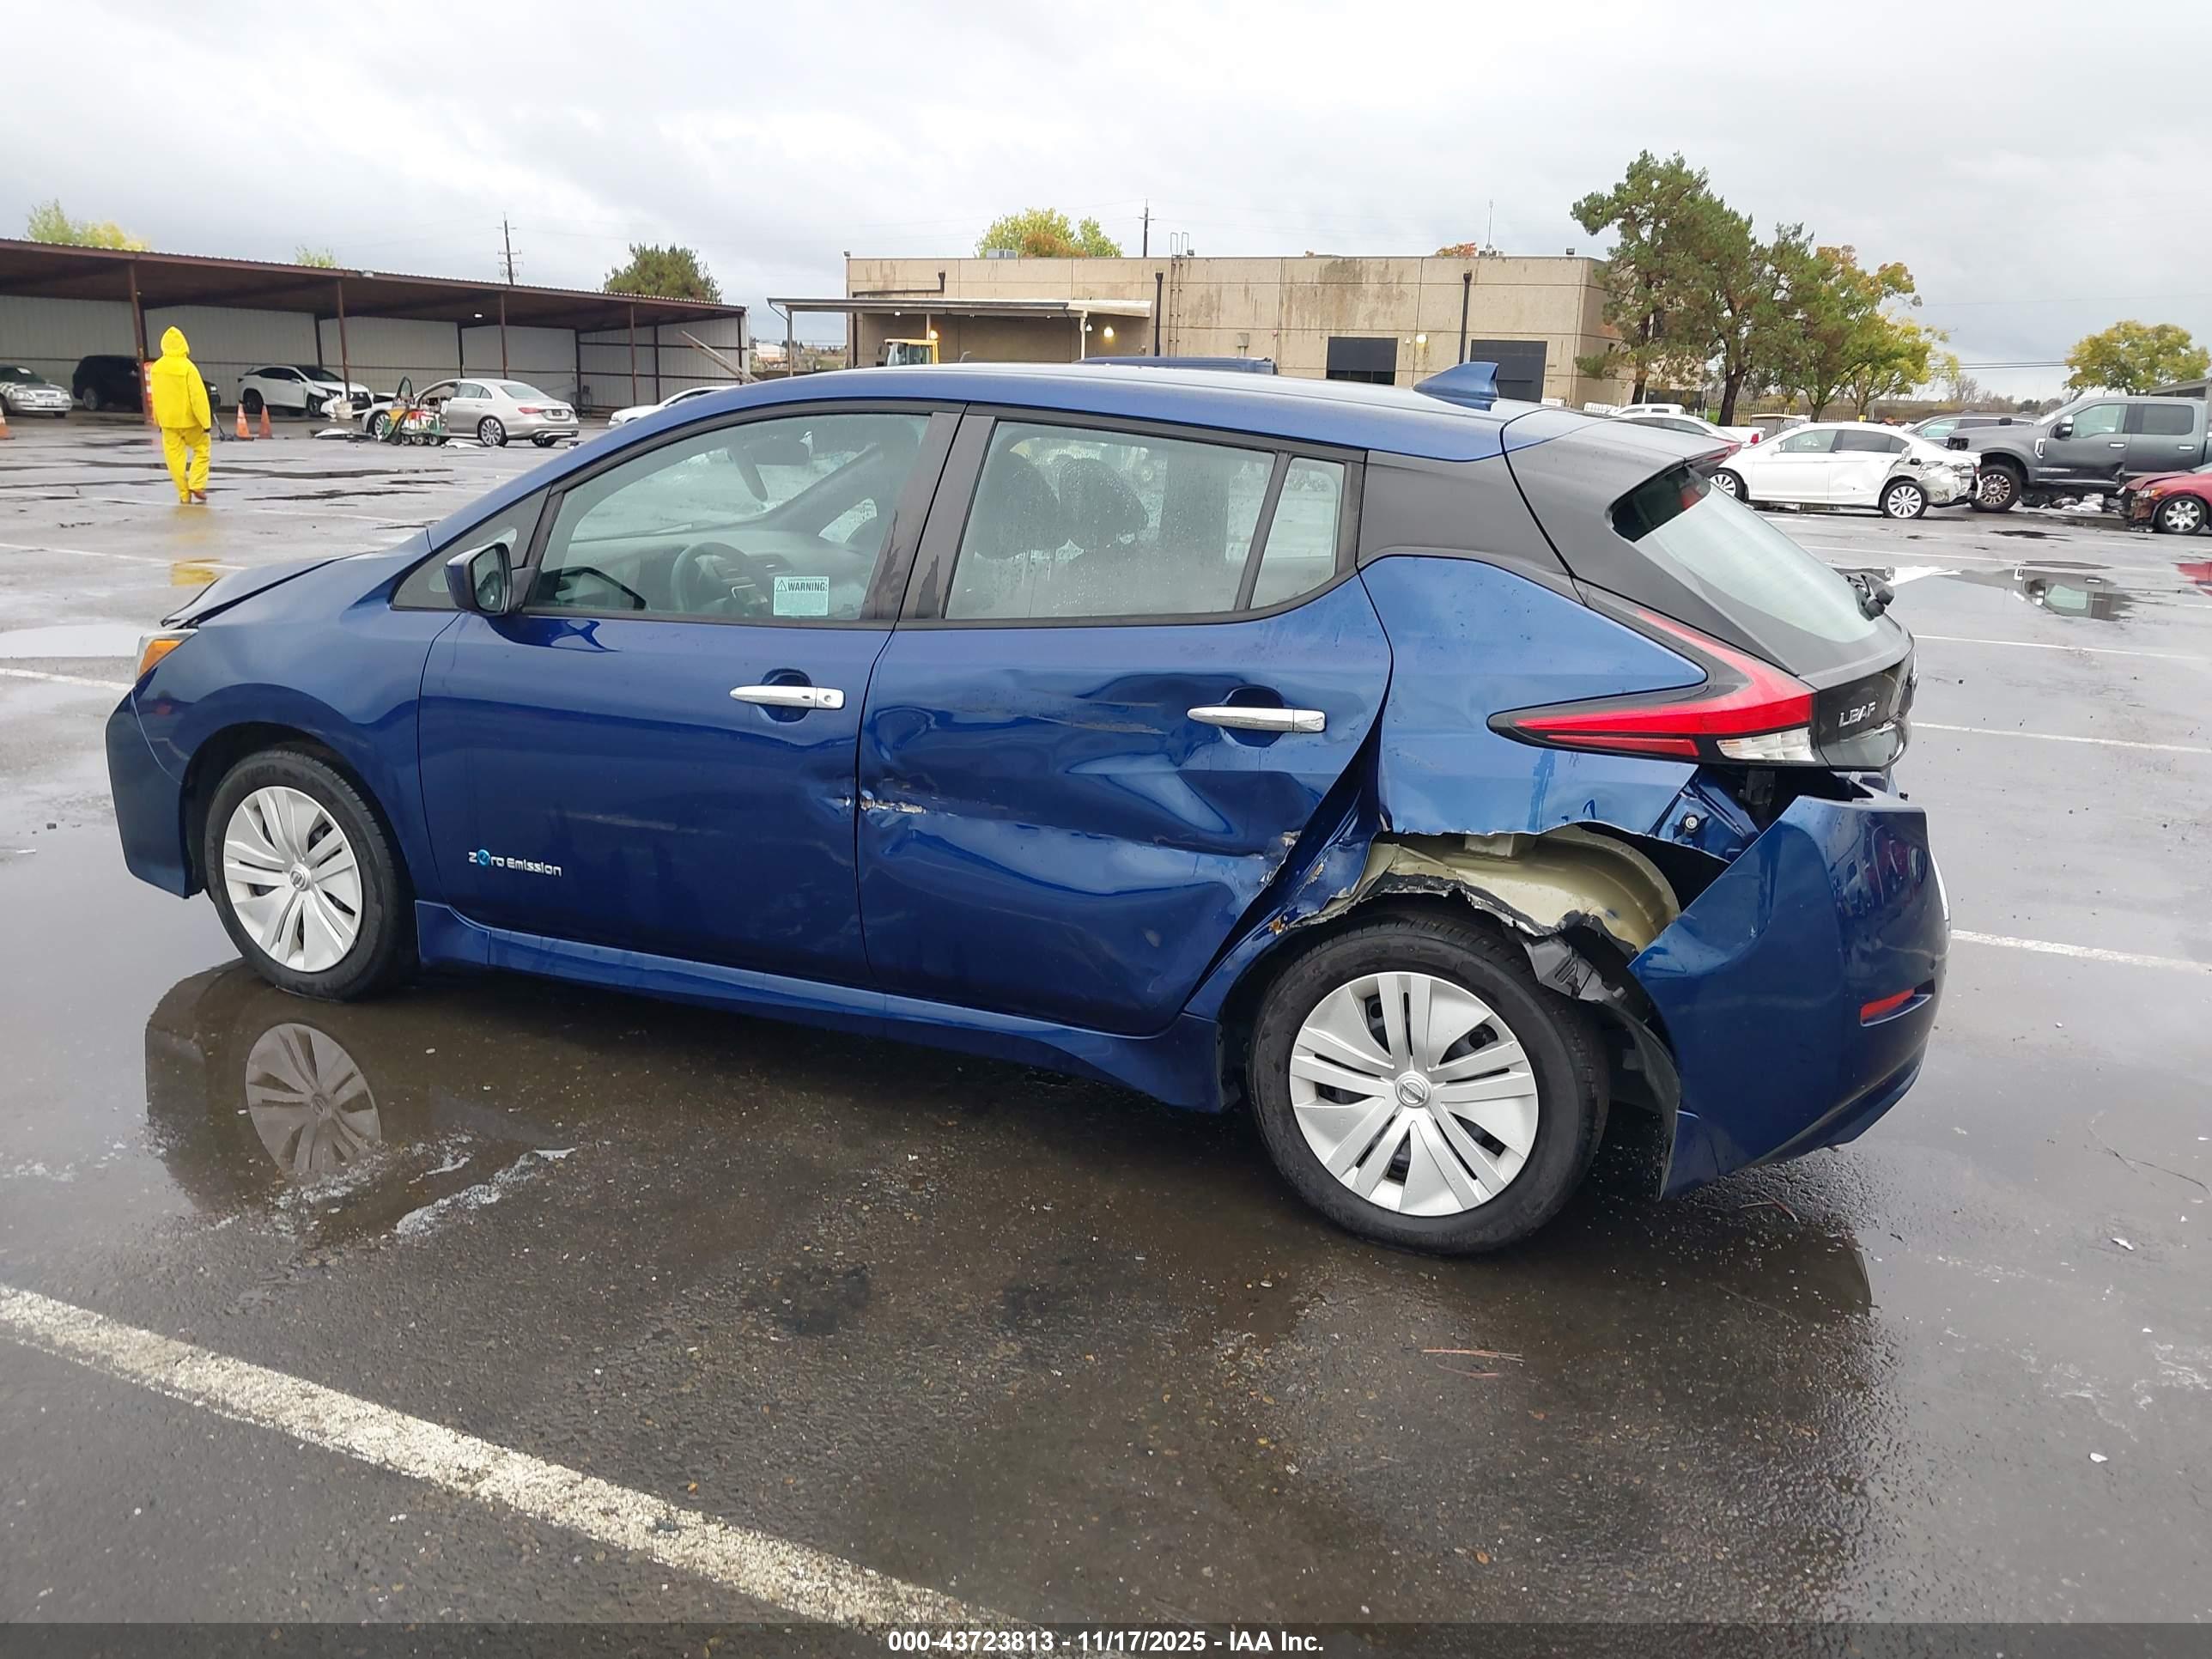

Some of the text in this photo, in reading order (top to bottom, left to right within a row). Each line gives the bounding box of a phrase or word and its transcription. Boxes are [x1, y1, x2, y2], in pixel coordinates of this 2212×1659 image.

[787, 581, 828, 592] WARNING:
[1838, 701, 1876, 728] LEAF
[506, 857, 562, 877] Emission
